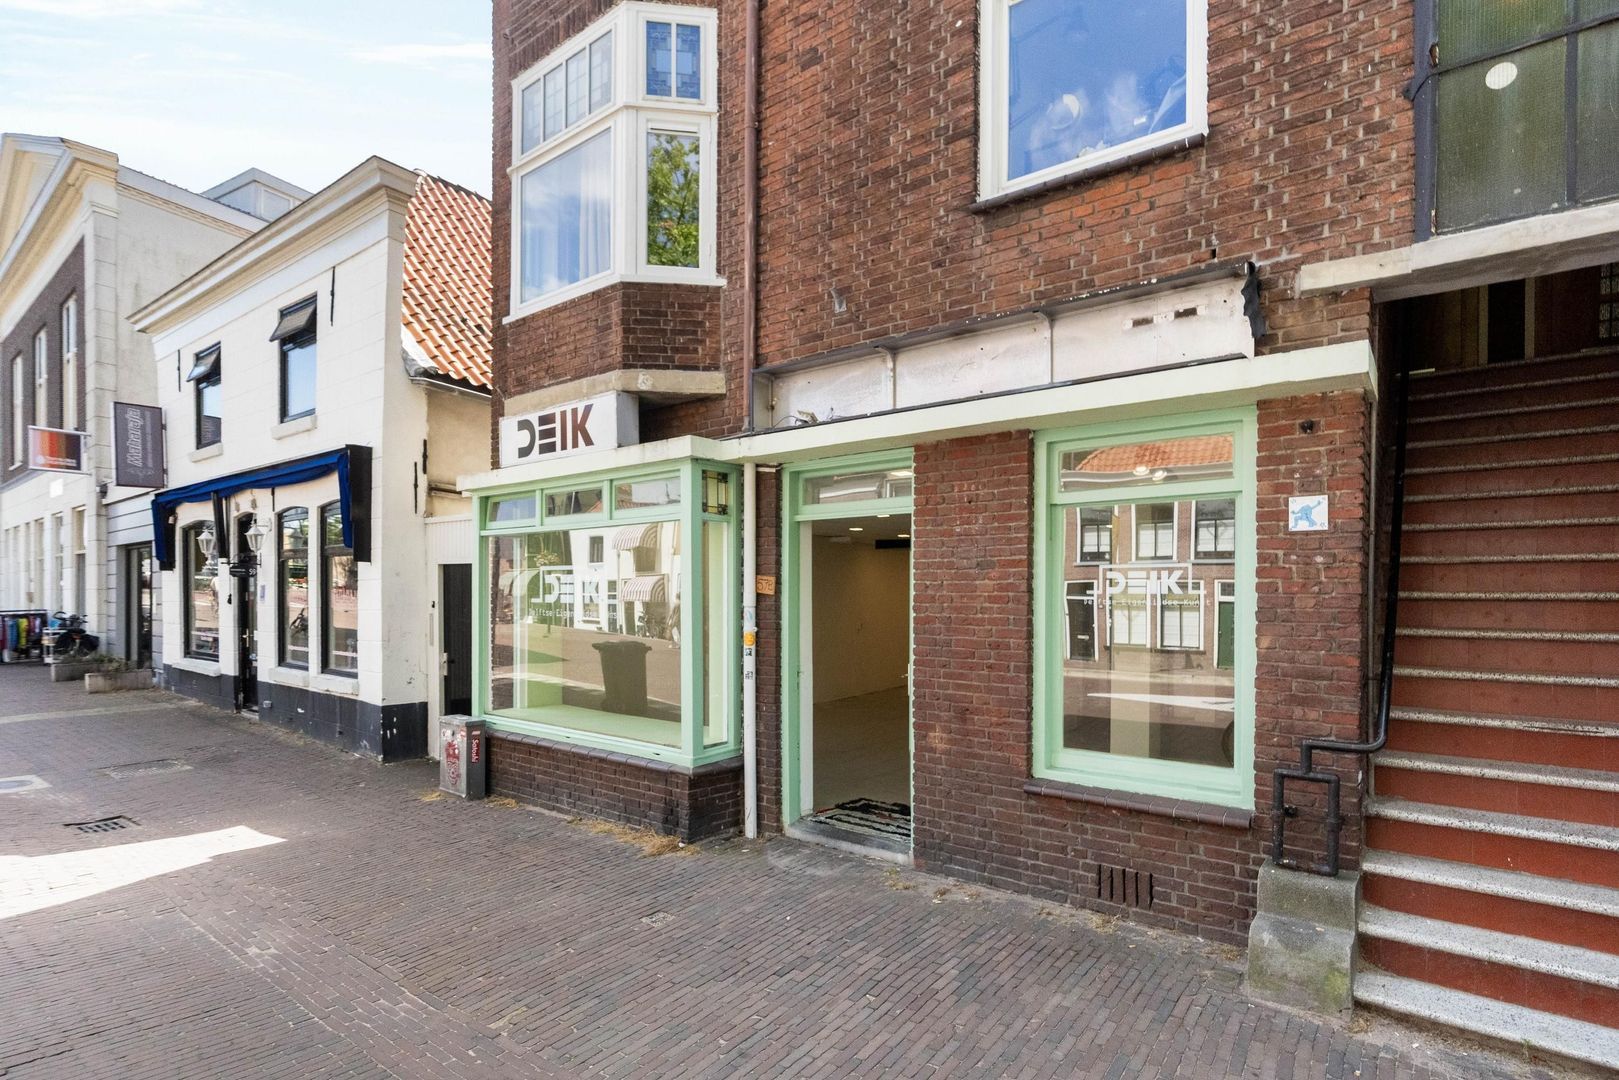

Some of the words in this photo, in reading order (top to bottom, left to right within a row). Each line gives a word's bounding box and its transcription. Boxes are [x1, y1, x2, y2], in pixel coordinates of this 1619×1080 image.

[126, 407, 143, 467] Maharaja
[517, 403, 595, 458] DEIK
[545, 574, 599, 603] DEK
[1106, 570, 1184, 594] DEIK
